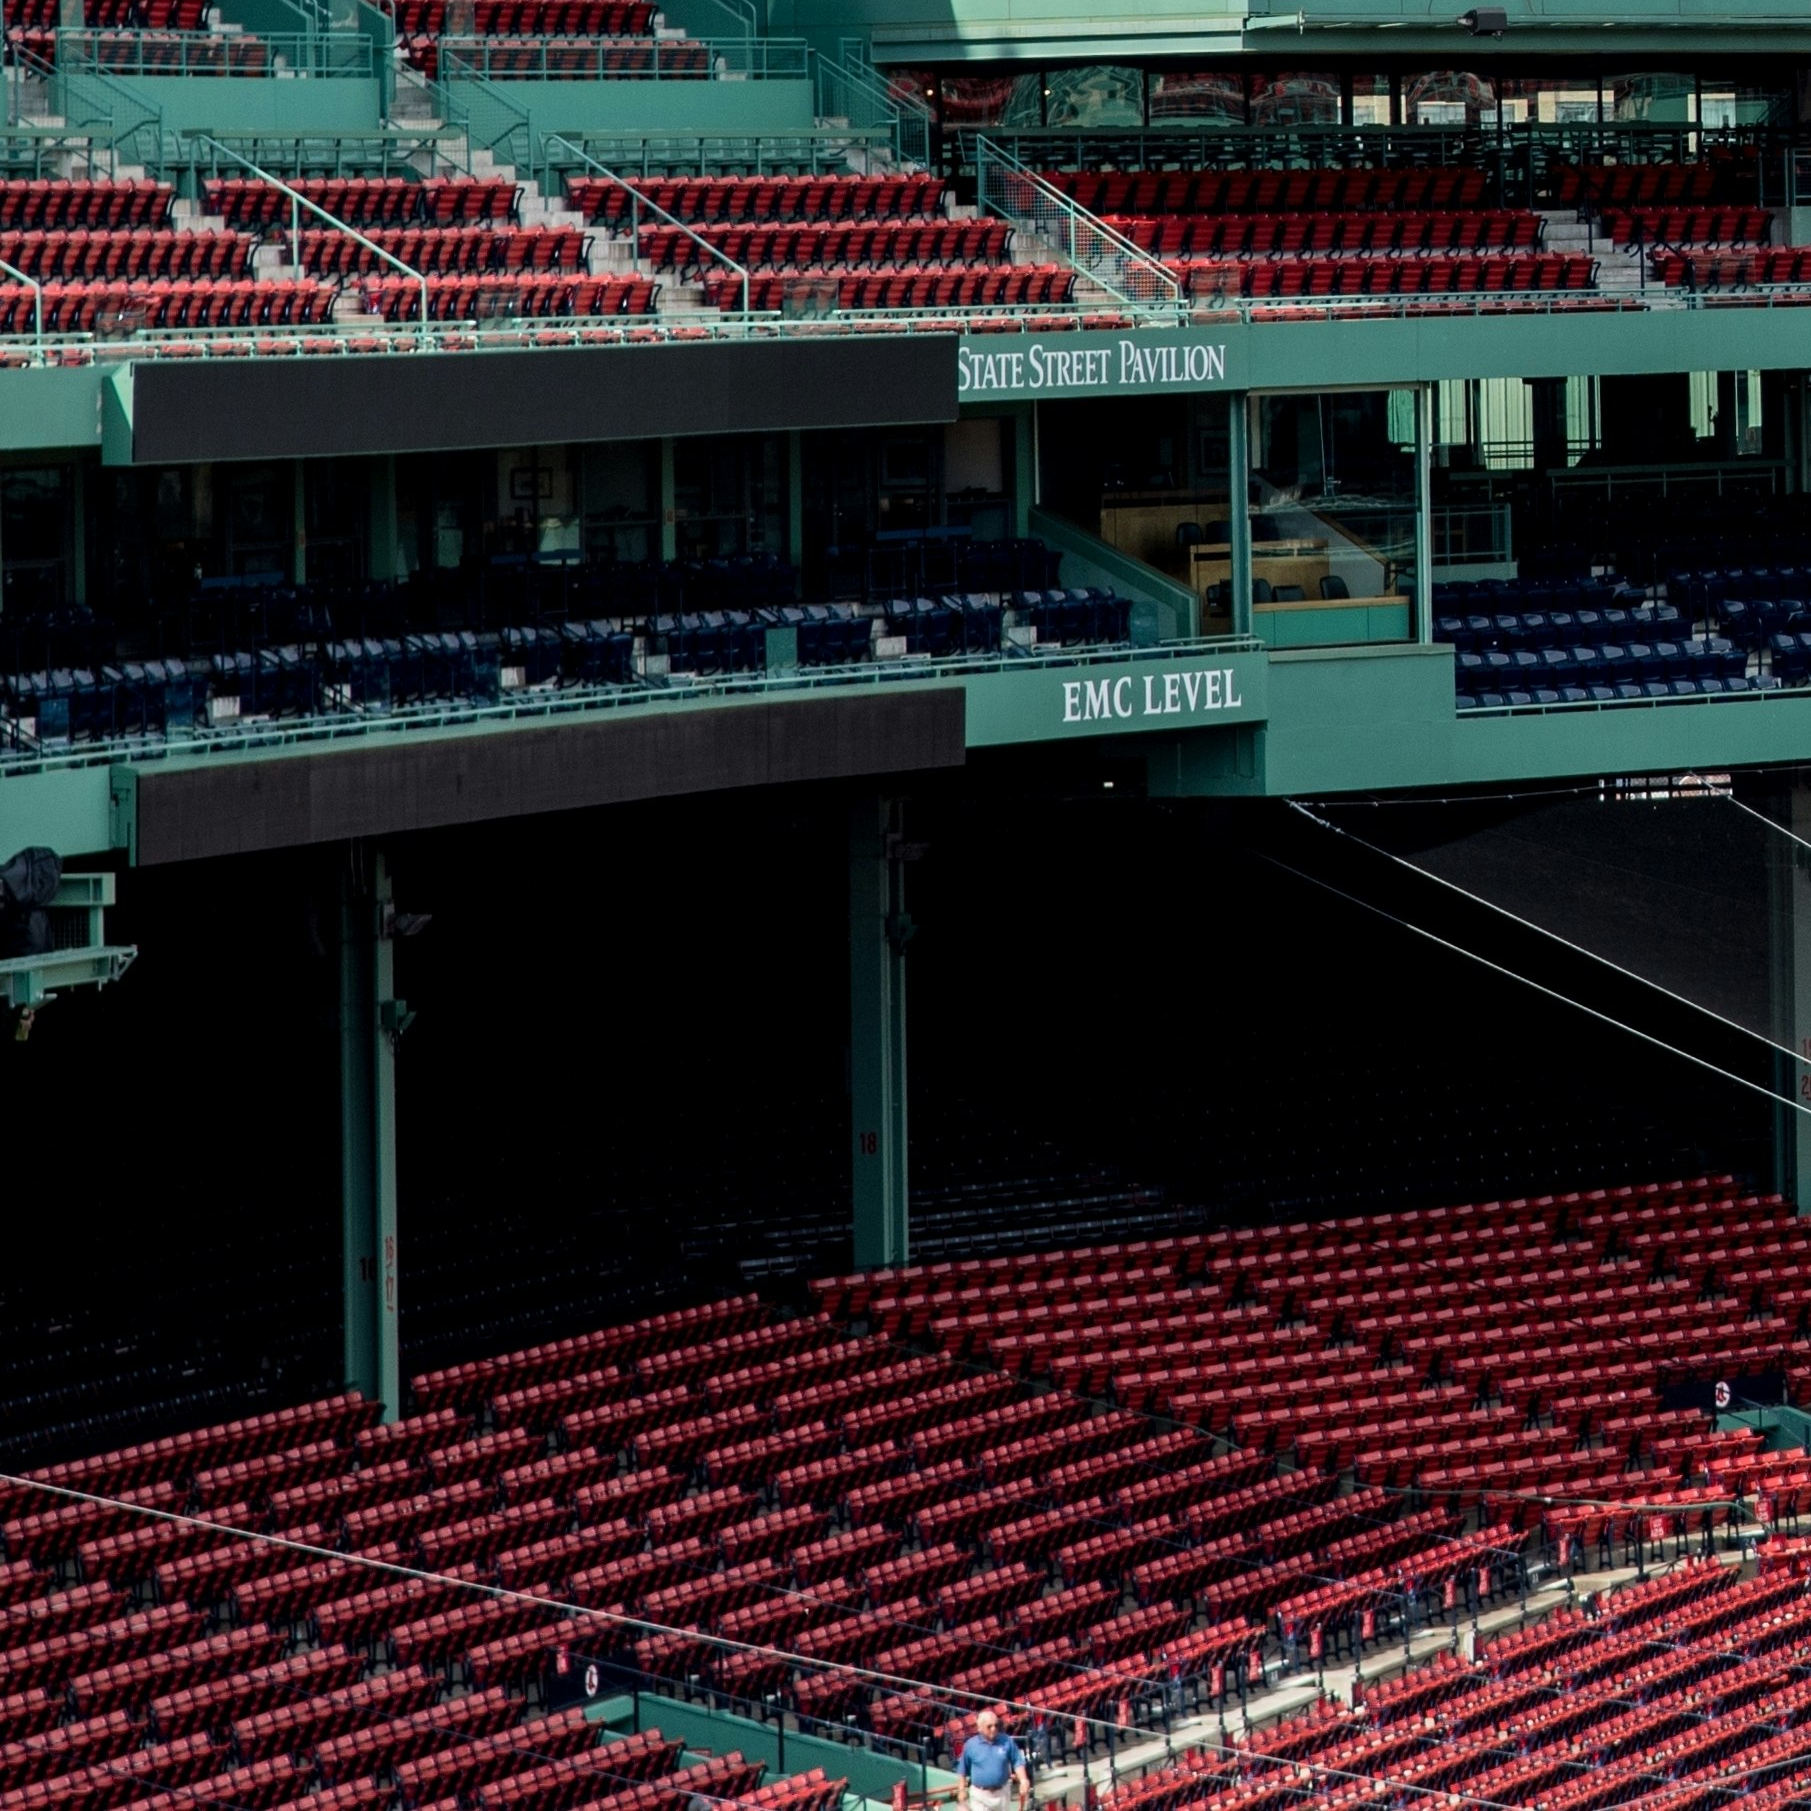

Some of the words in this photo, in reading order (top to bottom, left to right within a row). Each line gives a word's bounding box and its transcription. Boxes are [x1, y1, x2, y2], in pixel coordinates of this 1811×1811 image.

[958, 346, 1024, 391] STATE
[1028, 343, 1112, 388] STREET
[1118, 340, 1226, 384] PAVILION
[1062, 676, 1133, 722] EMC
[1144, 669, 1242, 716] LEVEL
[860, 1132, 878, 1155] 18
